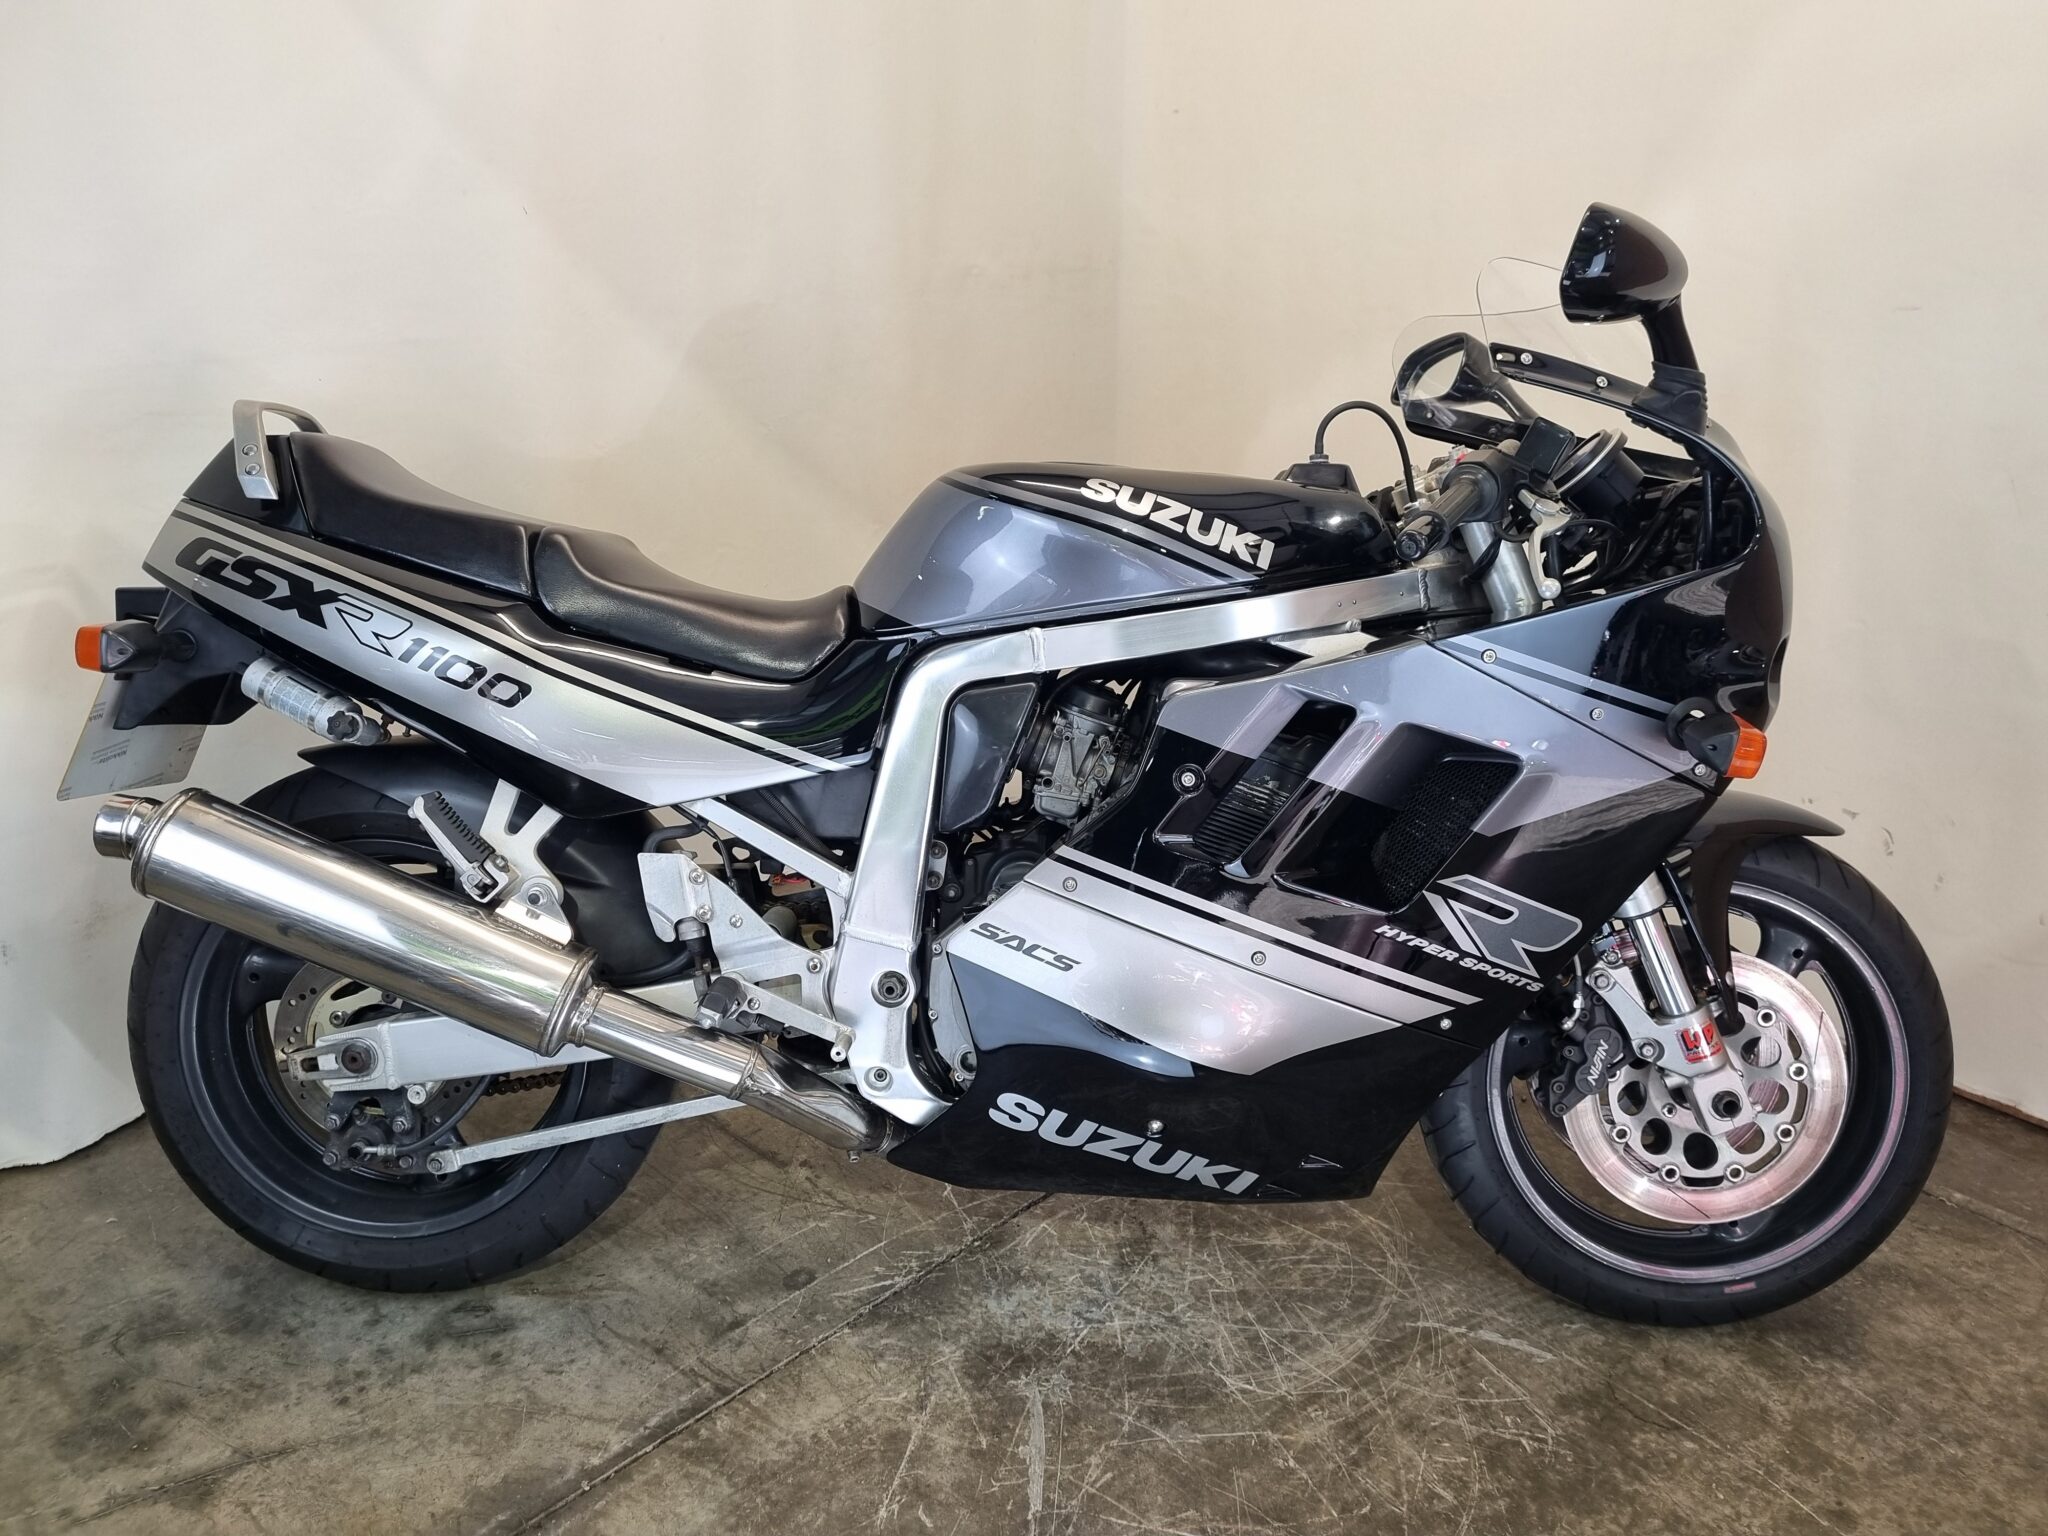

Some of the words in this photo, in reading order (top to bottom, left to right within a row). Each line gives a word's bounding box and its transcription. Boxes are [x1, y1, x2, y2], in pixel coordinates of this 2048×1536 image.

[1080, 478, 1276, 570] SUZUKI
[398, 637, 532, 708] 1100
[970, 922, 1082, 972] SACS
[1374, 925, 1459, 962] HYPER
[1459, 957, 1544, 992] SPORTS
[1422, 874, 1582, 979] R
[988, 1093, 1259, 1195] SUZUKI
